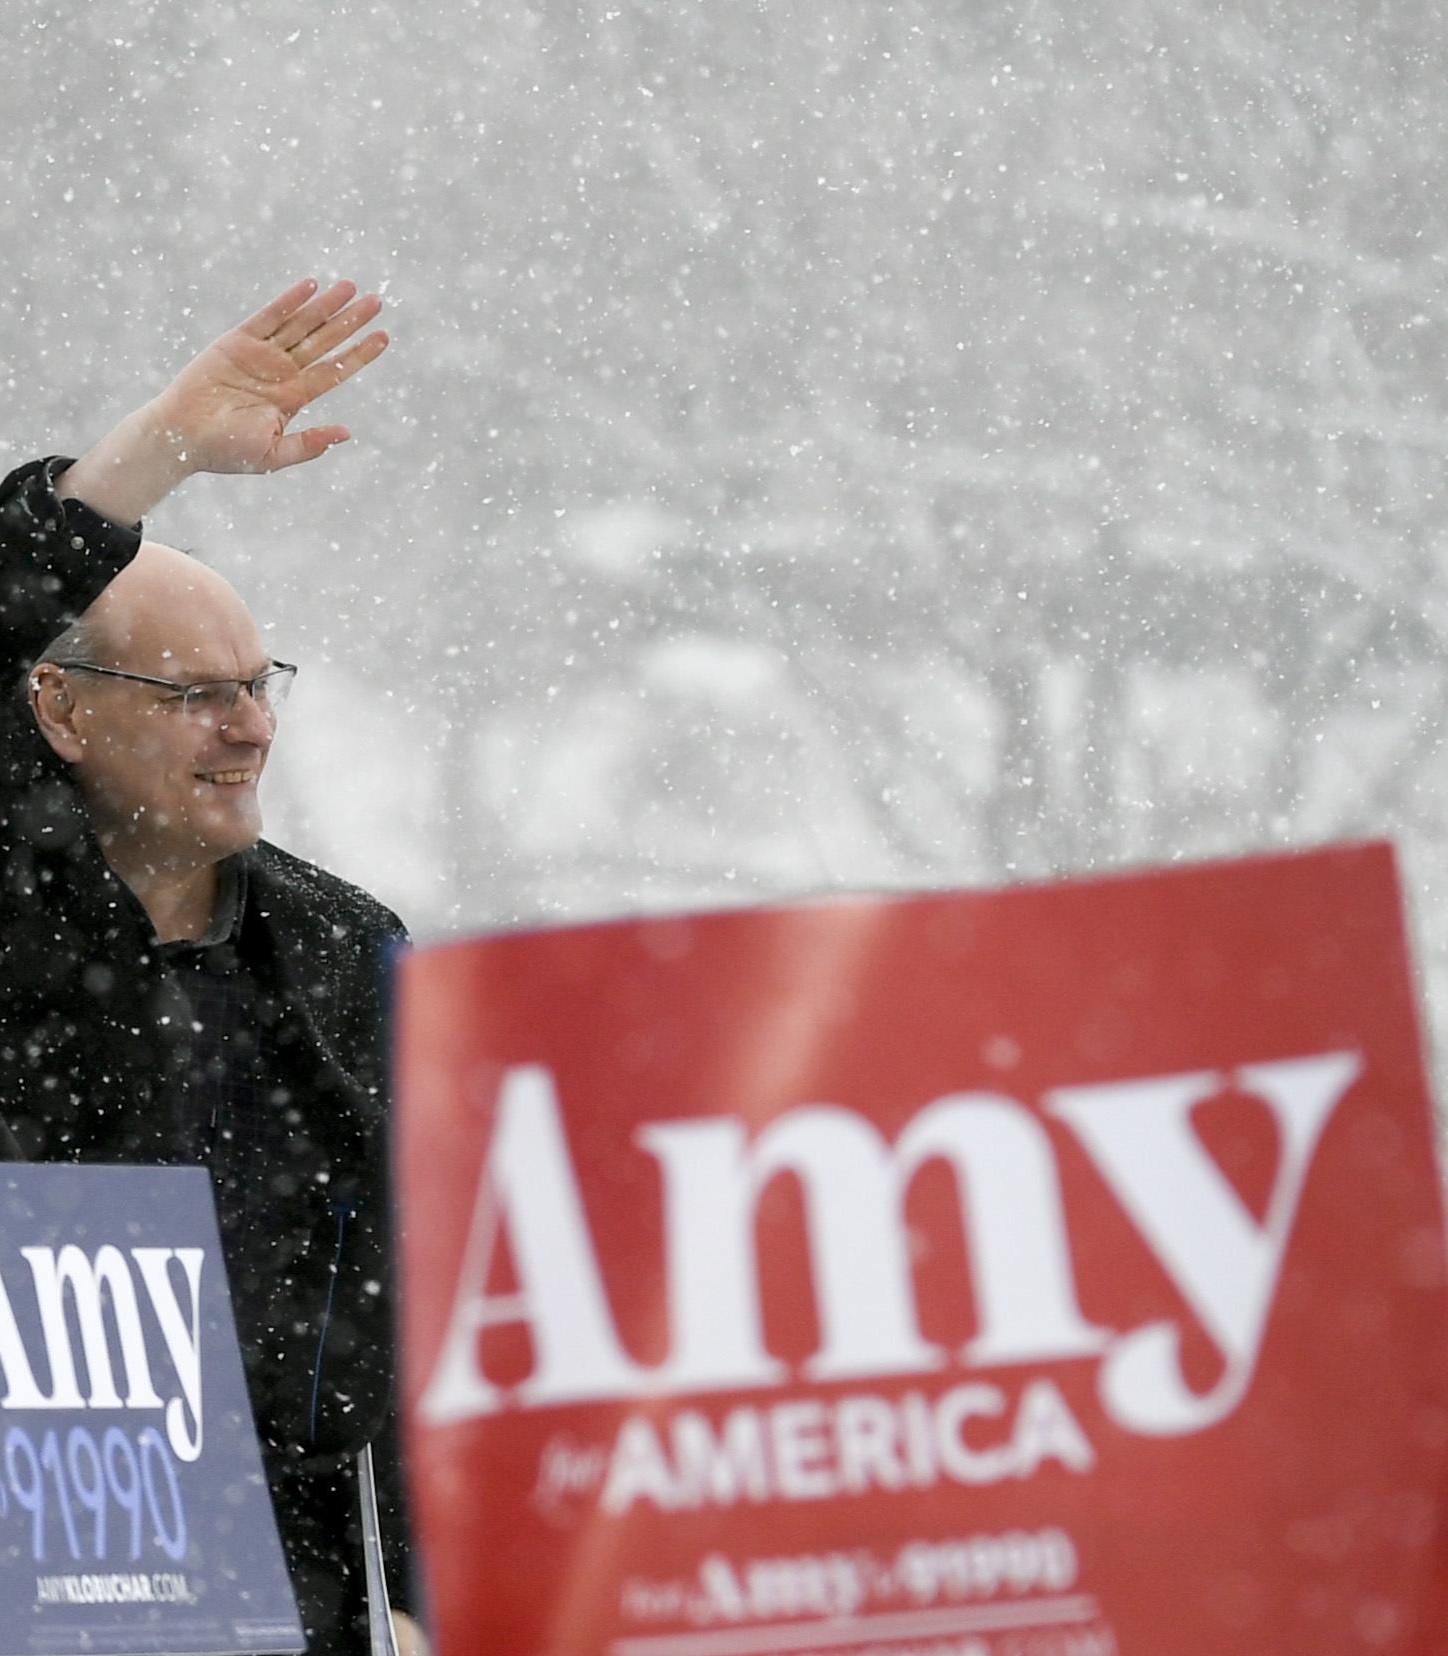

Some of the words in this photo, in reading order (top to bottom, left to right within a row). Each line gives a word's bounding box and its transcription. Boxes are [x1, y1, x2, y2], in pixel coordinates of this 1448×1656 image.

[419, 1050, 1365, 1437] Amy
[5, 1426, 188, 1562] 91990
[601, 1378, 1097, 1517] AMERICA
